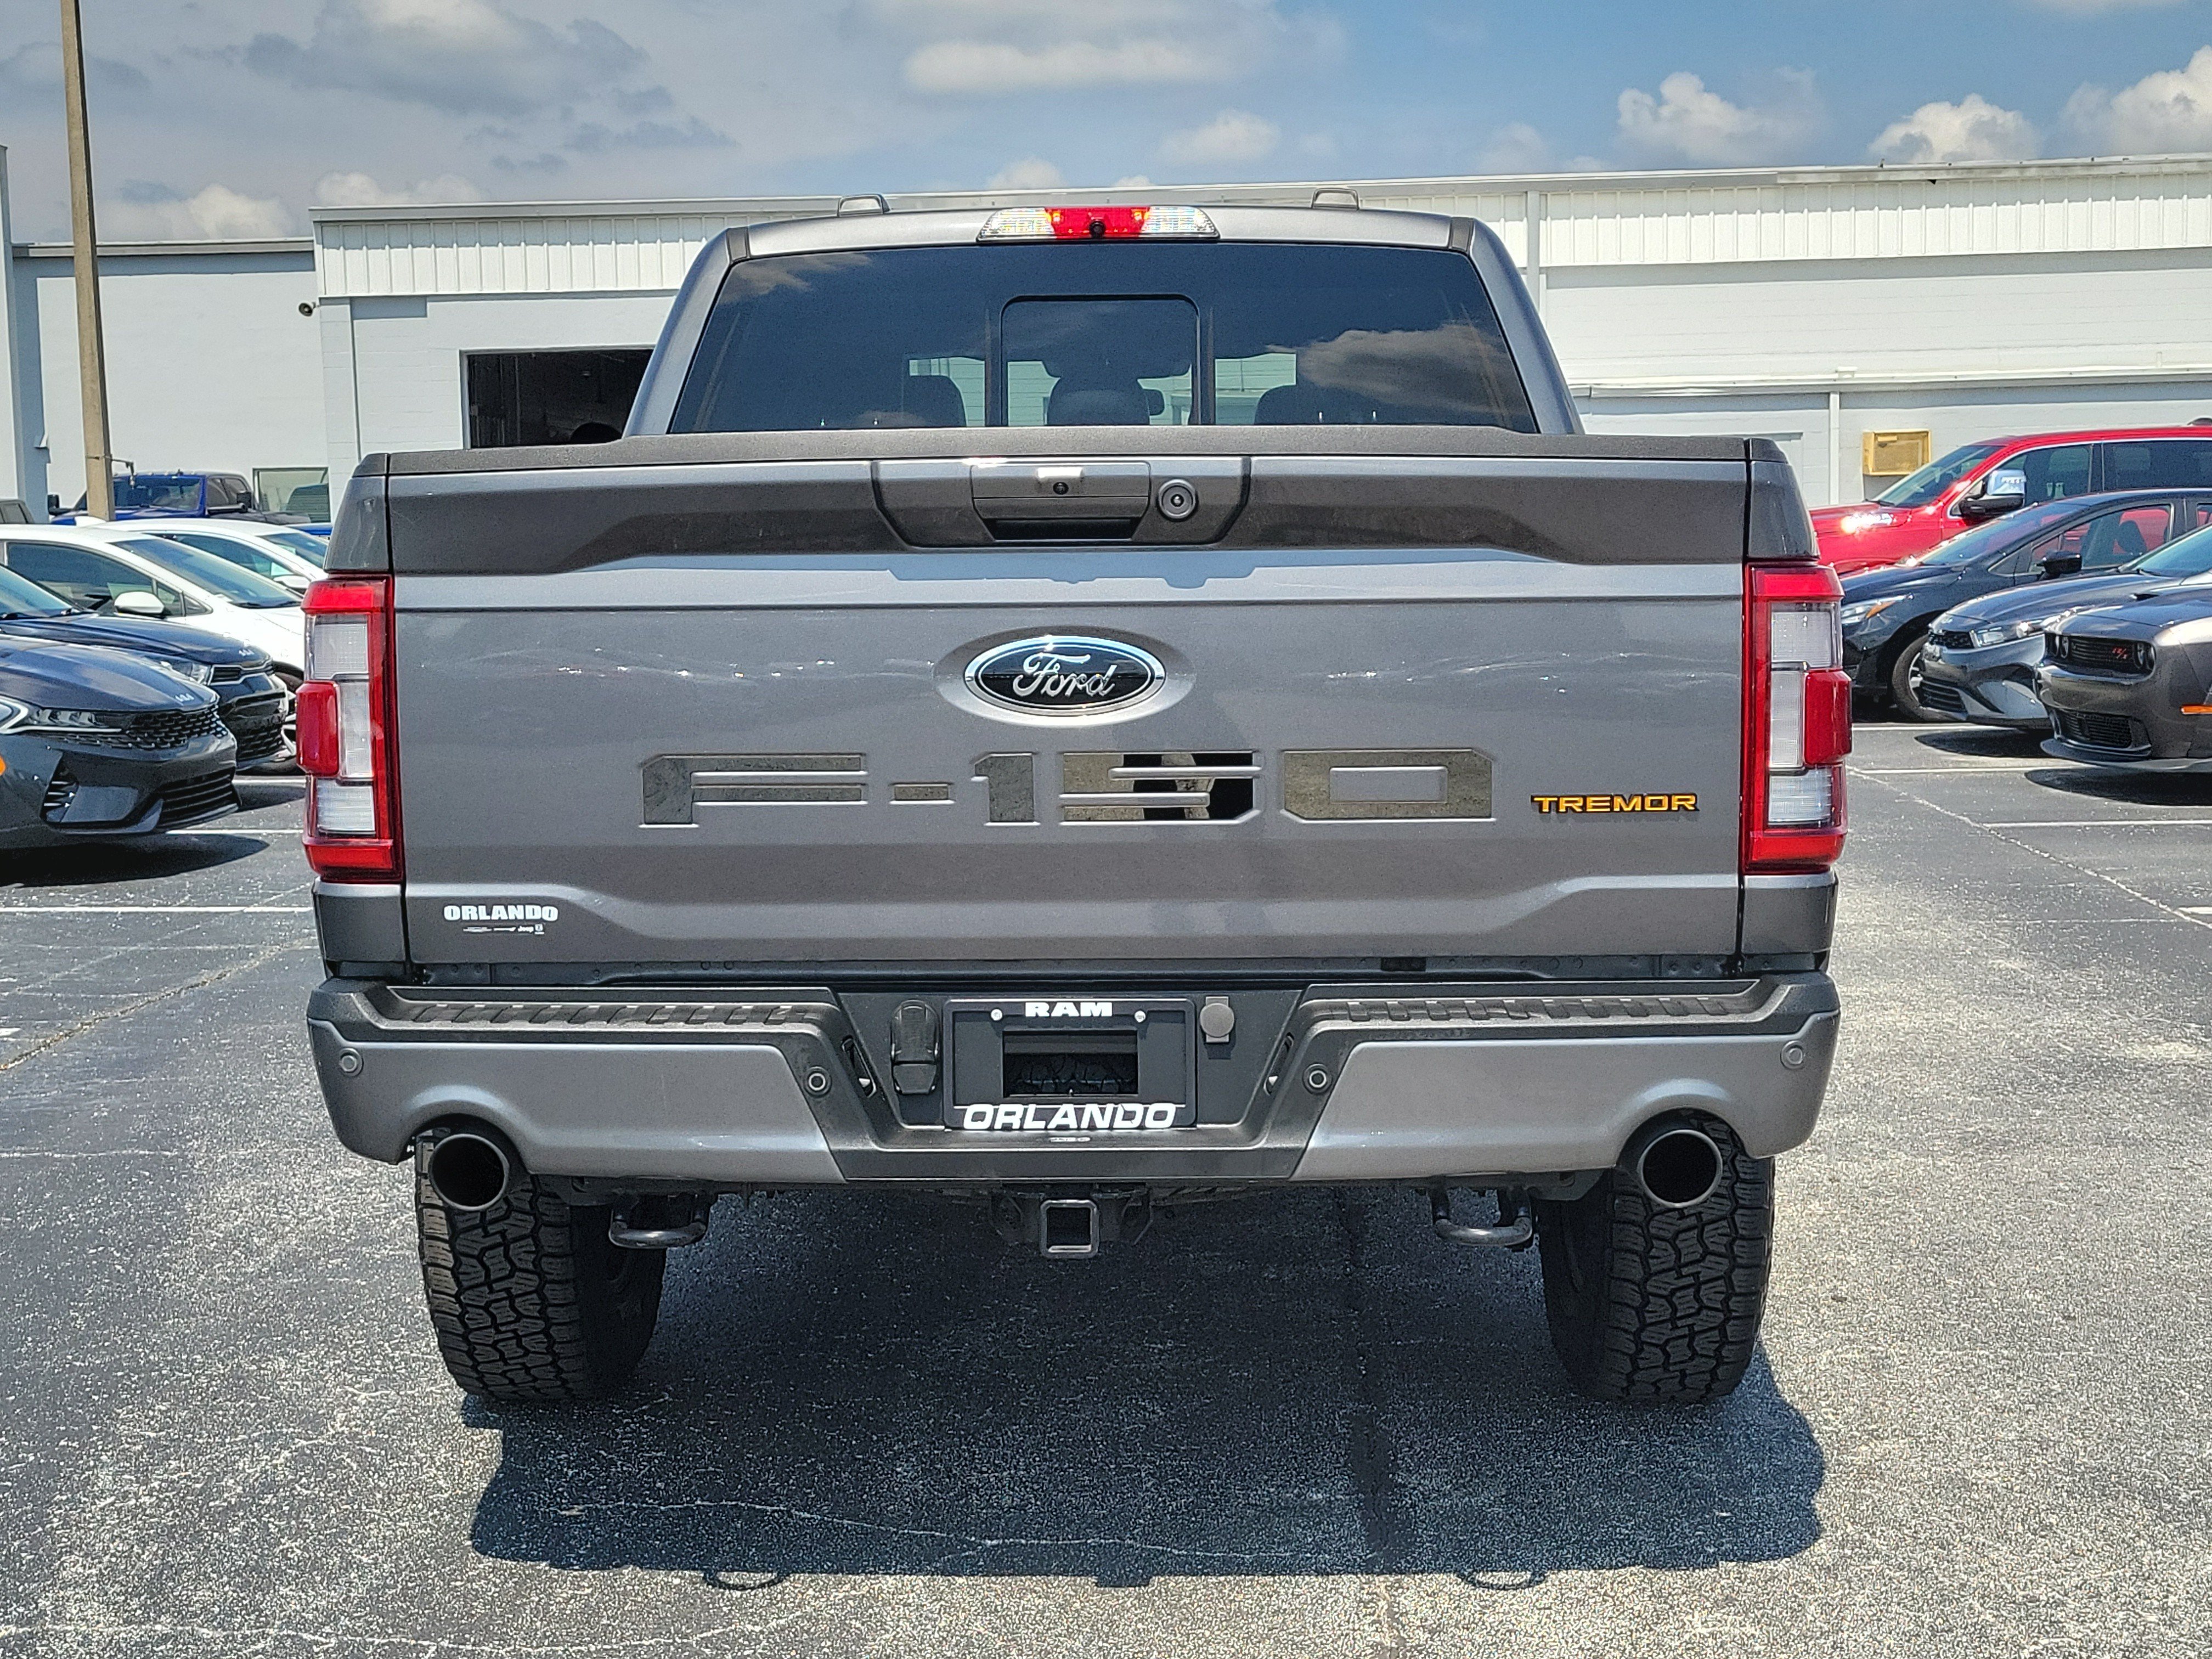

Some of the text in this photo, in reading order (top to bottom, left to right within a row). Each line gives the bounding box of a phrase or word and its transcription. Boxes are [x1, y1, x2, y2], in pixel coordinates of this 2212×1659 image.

[1013, 652, 1118, 697] Ford
[640, 749, 1496, 827] F-150
[1531, 793, 1700, 813] TREMOR
[444, 905, 558, 921] ORLANDO
[1025, 1002, 1113, 1017] RAM
[963, 1103, 1176, 1130] ORLANDO
